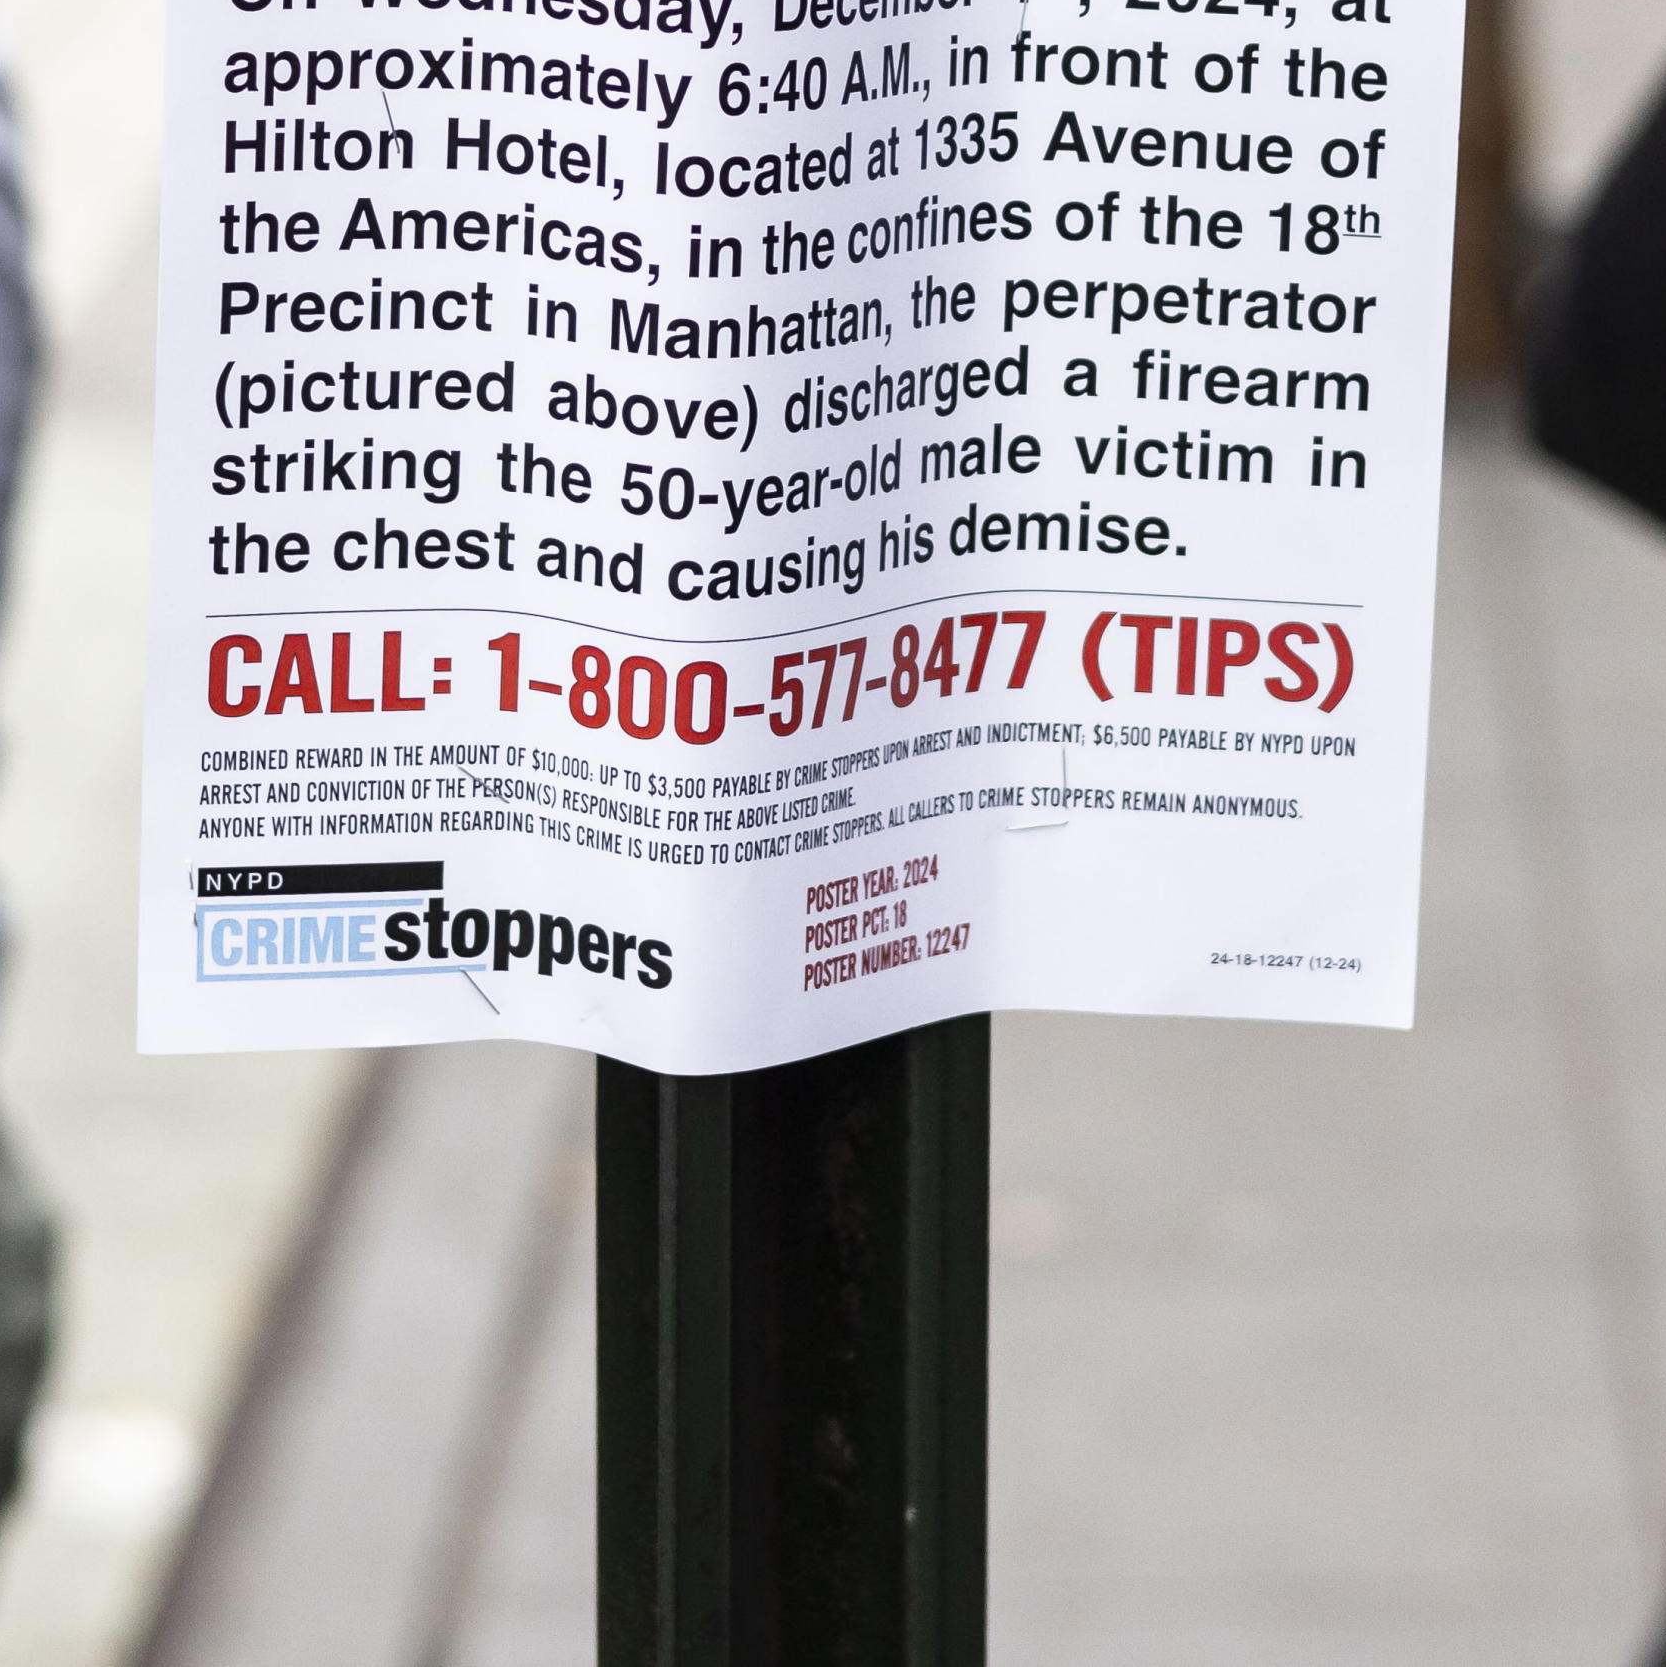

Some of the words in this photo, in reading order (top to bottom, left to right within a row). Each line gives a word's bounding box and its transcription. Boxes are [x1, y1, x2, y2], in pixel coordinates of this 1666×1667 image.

[225, 37, 692, 129] approximately
[719, 57, 827, 116] 6:40
[841, 42, 930, 105] A.M.,
[949, 35, 988, 86] in
[1011, 32, 1168, 89] front
[1195, 43, 1259, 94] of
[1284, 47, 1387, 102] the
[225, 115, 413, 173] Hilton
[447, 118, 623, 201] Hotel,
[656, 132, 852, 197] located
[868, 127, 899, 180] at
[915, 111, 1018, 170] 1335
[1043, 111, 1292, 174] Avenue
[1321, 129, 1385, 179] of
[220, 201, 319, 254] the
[339, 198, 659, 286] Americas,
[689, 225, 742, 278] in
[762, 221, 834, 275] the
[848, 195, 1032, 263] confines
[1056, 191, 1120, 241] of
[1140, 195, 1242, 249] the
[220, 278, 493, 334] Precinct
[528, 284, 576, 342] in
[611, 298, 891, 359] Manhattan,
[911, 275, 975, 329] the
[1004, 278, 1376, 334] perpetrator
[216, 360, 514, 428] (pictured
[549, 374, 757, 452] above)
[785, 345, 1028, 433] discharged
[1064, 358, 1098, 396] a
[1133, 349, 1369, 411] firearm
[212, 438, 460, 504] striking
[497, 443, 591, 503] the
[621, 438, 901, 534] 50-year-old
[921, 423, 1041, 483] male
[1075, 425, 1272, 483] victim
[1311, 436, 1365, 488] in
[209, 523, 310, 575] the
[334, 518, 515, 571] chest
[537, 538, 643, 594] and
[668, 536, 865, 601] causing
[880, 514, 934, 572] his
[950, 501, 1186, 556] demise.
[208, 631, 452, 718] CALL:
[488, 611, 1046, 745] 1-800-577-8477
[1082, 611, 1354, 713] (TIPS)
[202, 750, 287, 772] COMBINED
[296, 748, 362, 769] REWARD
[371, 747, 386, 767] IN
[394, 746, 423, 766] THE
[430, 745, 500, 765] AMOUNT
[507, 746, 526, 766] OF
[533, 749, 596, 783] $10,000:
[600, 765, 618, 786] UP
[624, 770, 641, 792] TO
[648, 774, 705, 799] $3,500
[713, 772, 771, 798] PAYABLE
[776, 769, 791, 791] BY
[795, 761, 828, 787] CRIME
[832, 747, 879, 778] STOPPERS
[884, 740, 909, 764] UPON
[913, 730, 952, 756] ARREST
[956, 726, 981, 747] AND
[987, 723, 1085, 746] INDICTMENT;
[1094, 725, 1151, 749] $6,500
[1159, 728, 1227, 750] PAYABLE
[1235, 732, 1254, 751] BY
[1262, 734, 1303, 754] NYPD
[1312, 736, 1355, 756] UPON
[199, 817, 265, 838] ANYONE
[272, 816, 312, 836] WITH
[321, 812, 432, 835] INFORMATION
[441, 811, 533, 833] REGARDING
[540, 817, 570, 842] THIS
[577, 826, 622, 854] CRIME
[629, 837, 642, 858] IS
[649, 841, 704, 864] URGED
[711, 844, 728, 864] TO
[735, 834, 791, 862] CONTACT
[795, 826, 829, 852] CRIME
[833, 812, 884, 843] STOPPERS.
[889, 806, 905, 828] ALL
[909, 794, 954, 822] CALLERS
[959, 791, 973, 811] TO
[979, 787, 1024, 809] CRIME
[1032, 787, 1114, 809] STOPPERS
[1122, 791, 1185, 812] REMAIN
[1193, 795, 1303, 819] ANONYMOUS.
[200, 784, 261, 805] ARREST
[267, 783, 300, 803] AND
[307, 780, 404, 802] CONVICTION
[412, 779, 431, 799] OF
[436, 778, 466, 798] THE
[473, 777, 556, 808] PERSON(S)
[563, 789, 661, 828] RESPONSIBLE
[668, 811, 698, 831] FOR
[704, 810, 732, 831] THE
[737, 804, 778, 829] ABOVE
[782, 796, 818, 822] LISTED
[822, 787, 857, 813] CRIME.
[205, 872, 284, 892] NYPD
[807, 876, 858, 914] POSTER
[863, 866, 898, 899] YEAR:
[903, 854, 938, 888] 2024
[804, 952, 856, 992] POSTER
[861, 935, 921, 976] NUMBER:
[926, 923, 970, 957] 12247
[805, 914, 857, 953] POSTER
[862, 905, 889, 938] PCT:
[893, 900, 907, 928] 18
[1309, 957, 1361, 973] (12-24)
